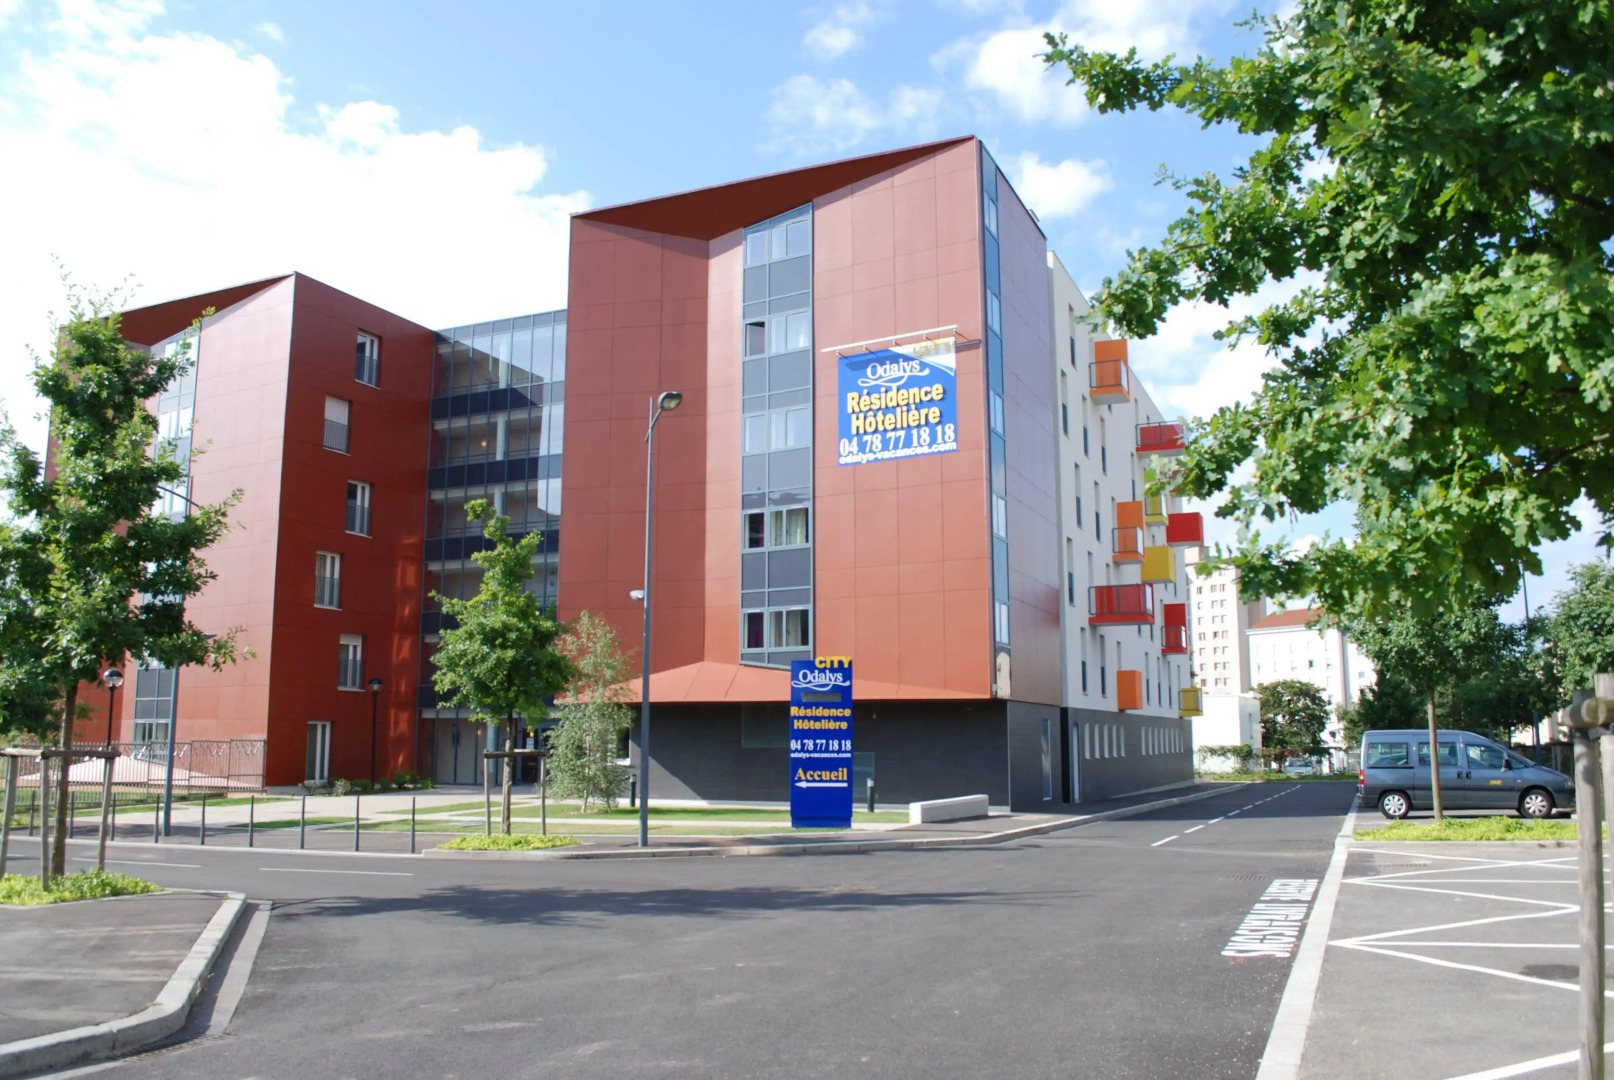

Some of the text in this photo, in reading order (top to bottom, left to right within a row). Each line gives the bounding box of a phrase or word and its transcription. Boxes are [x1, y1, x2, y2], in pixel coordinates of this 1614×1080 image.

[867, 359, 921, 382] Odalys
[847, 383, 945, 414] Résidence
[851, 404, 942, 435] Hôtelière
[839, 423, 955, 456] 04 78 77 18 18
[839, 441, 957, 465] odalys-vacances.com
[815, 656, 851, 669] CITY
[798, 669, 844, 686] Odalys
[790, 706, 851, 717] Résidence
[793, 719, 848, 730] Hôtelière
[790, 739, 851, 751] 04 78 77 18 18
[794, 767, 848, 781] Accueil
[1220, 903, 1309, 958] LIVRAISONS
